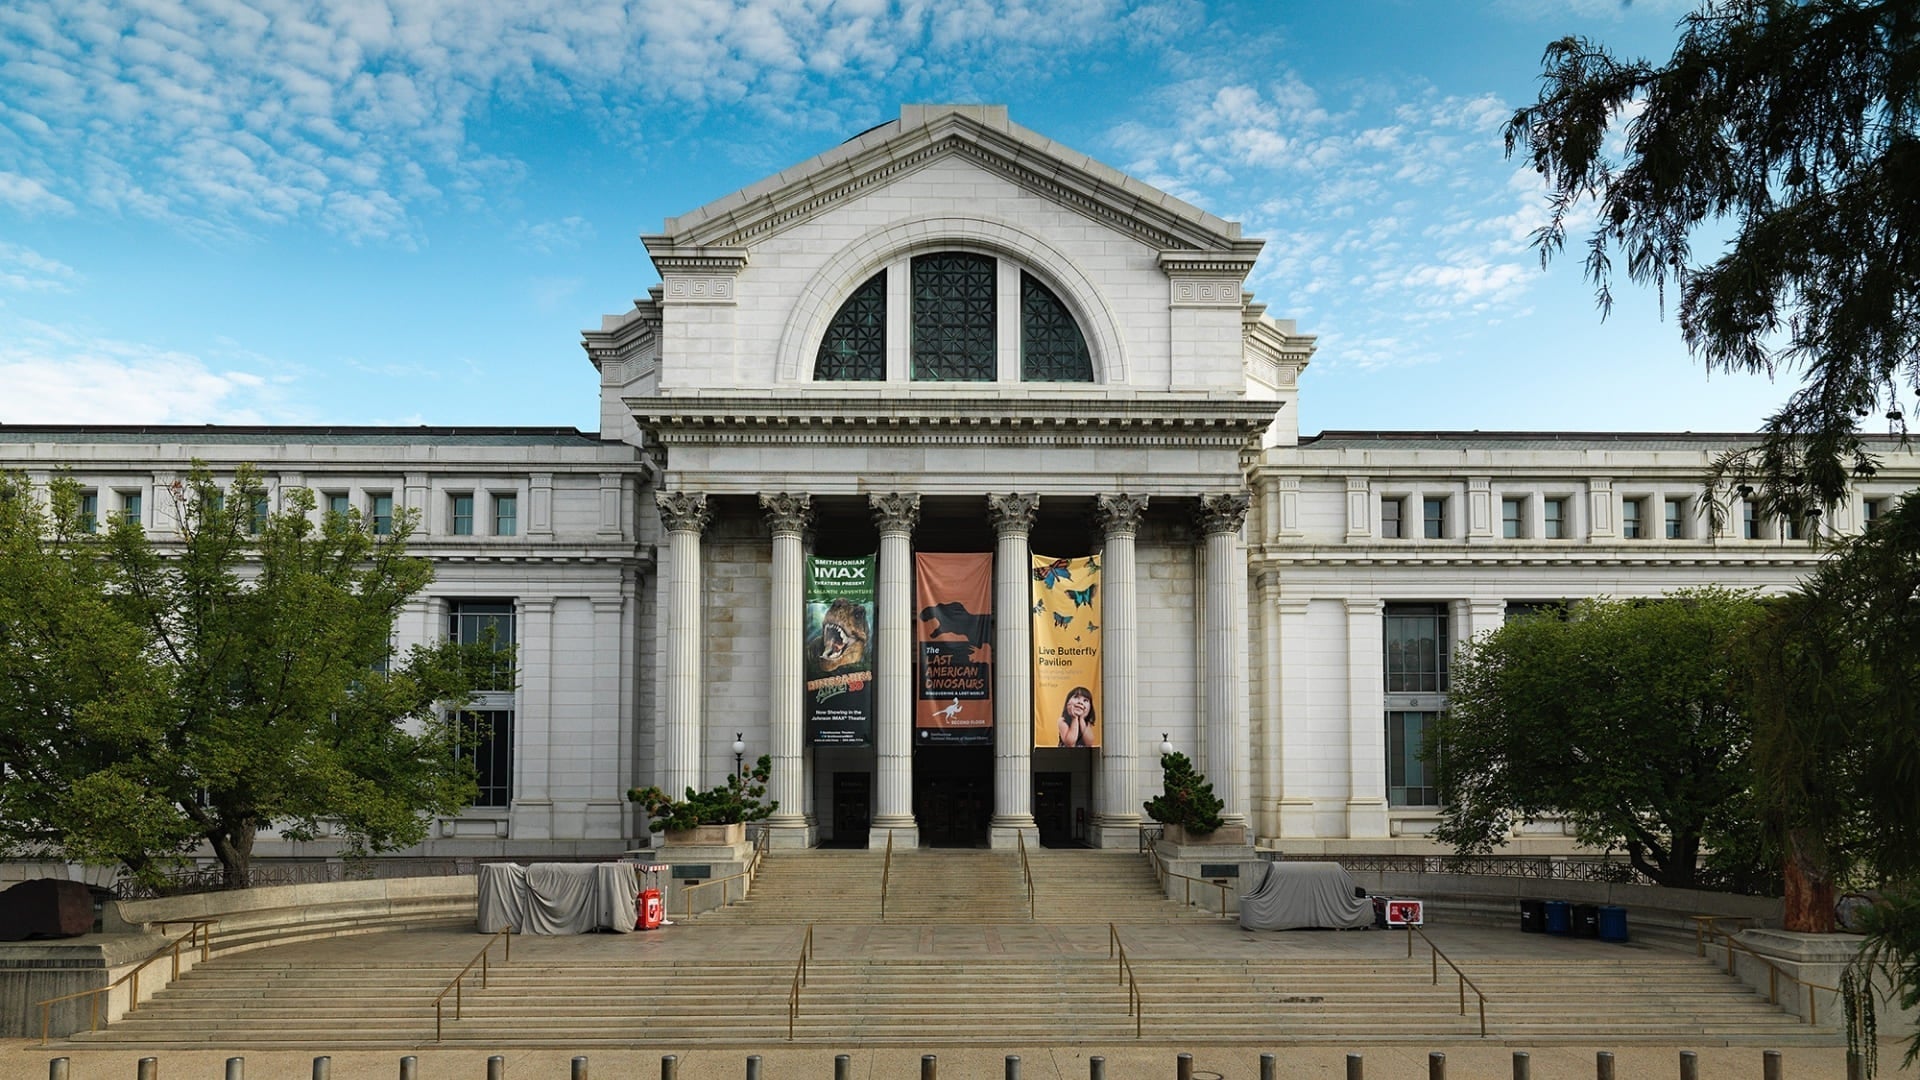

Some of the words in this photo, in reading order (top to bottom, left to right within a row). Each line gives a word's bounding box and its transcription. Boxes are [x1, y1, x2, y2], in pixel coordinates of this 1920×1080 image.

[814, 568, 866, 578] IMAX
[1039, 646, 1056, 655] Live
[1058, 647, 1097, 656] Butterfly
[926, 655, 953, 665] LAST
[1038, 658, 1072, 666] Pavilion
[925, 666, 978, 677] AMERICAN
[807, 671, 872, 691] DINOSAURS
[925, 678, 984, 689] DINOSAURS
